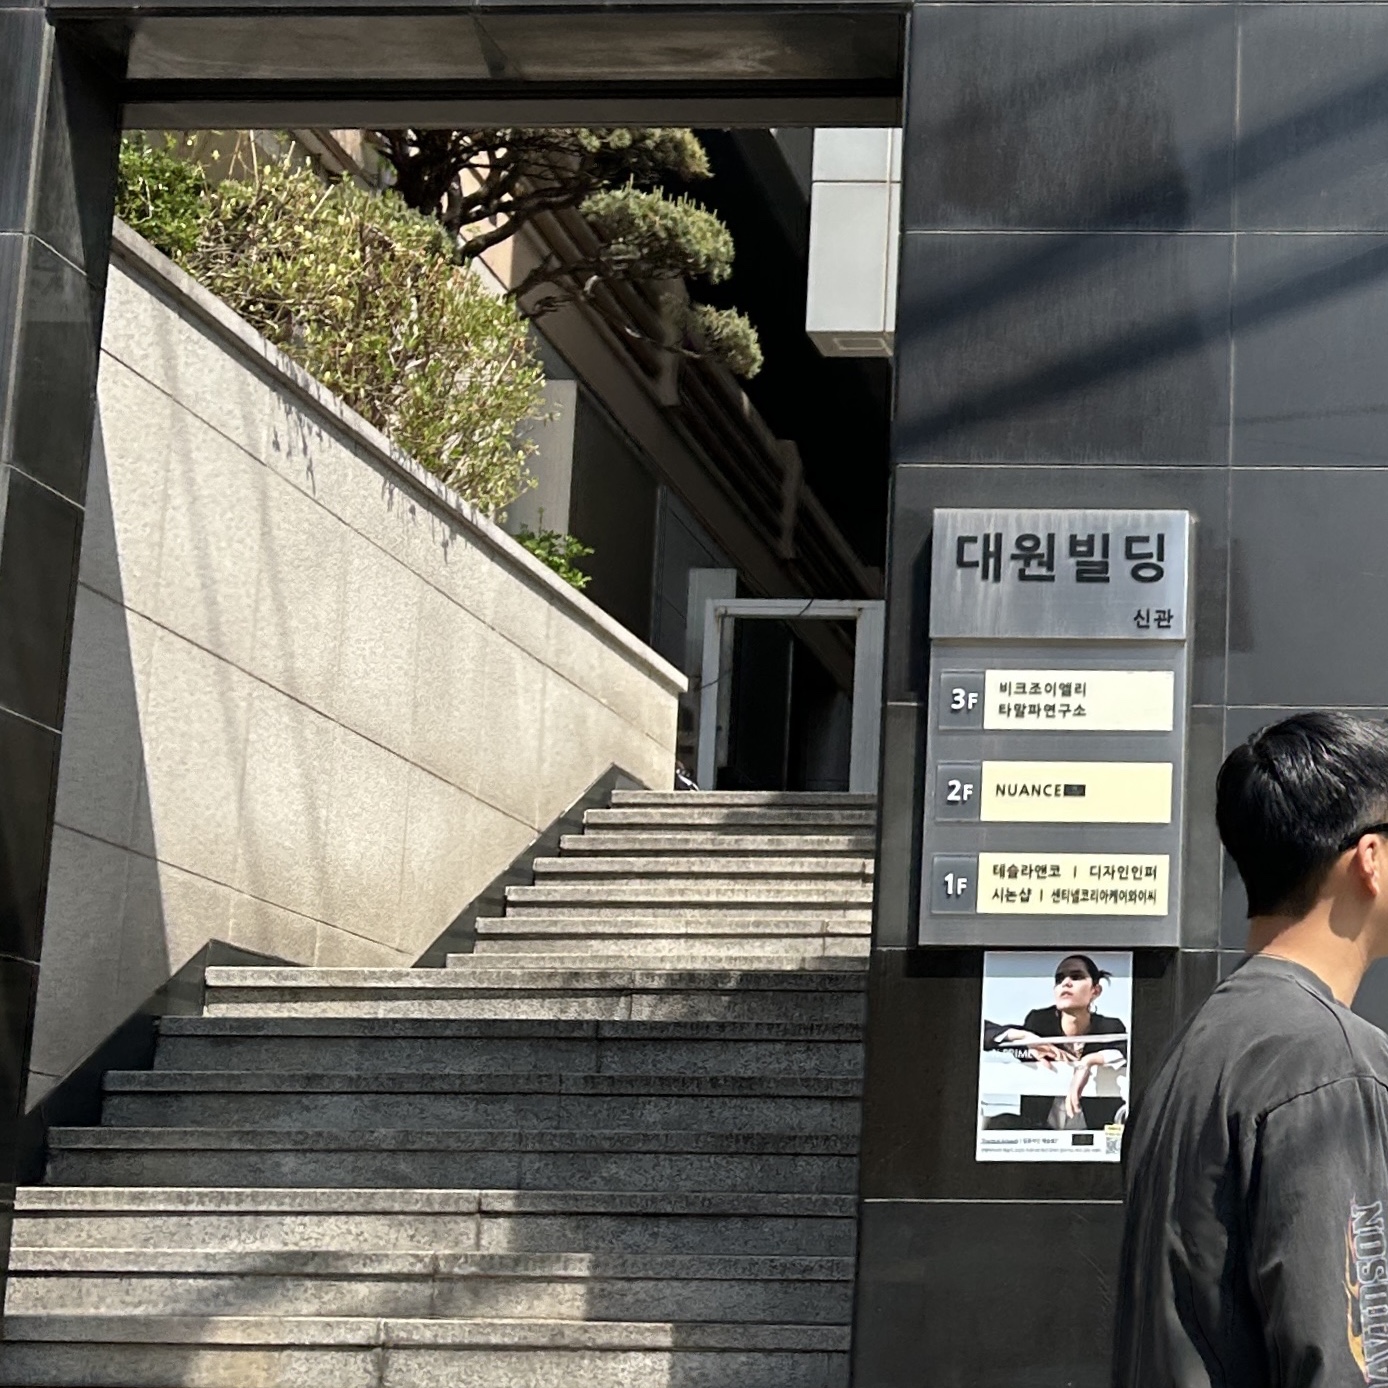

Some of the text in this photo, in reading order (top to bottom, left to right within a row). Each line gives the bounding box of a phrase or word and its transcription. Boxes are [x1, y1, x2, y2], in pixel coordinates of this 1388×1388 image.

[957, 532, 1165, 583] 대원빌딩
[1133, 608, 1174, 629] 신관
[950, 688, 979, 711] 3F
[998, 702, 1087, 719] 타말파연구소
[946, 779, 974, 803] 2F
[995, 783, 1062, 798] NUANCE
[1089, 863, 1158, 882] 디자인인퍼
[943, 872, 968, 896] 1F
